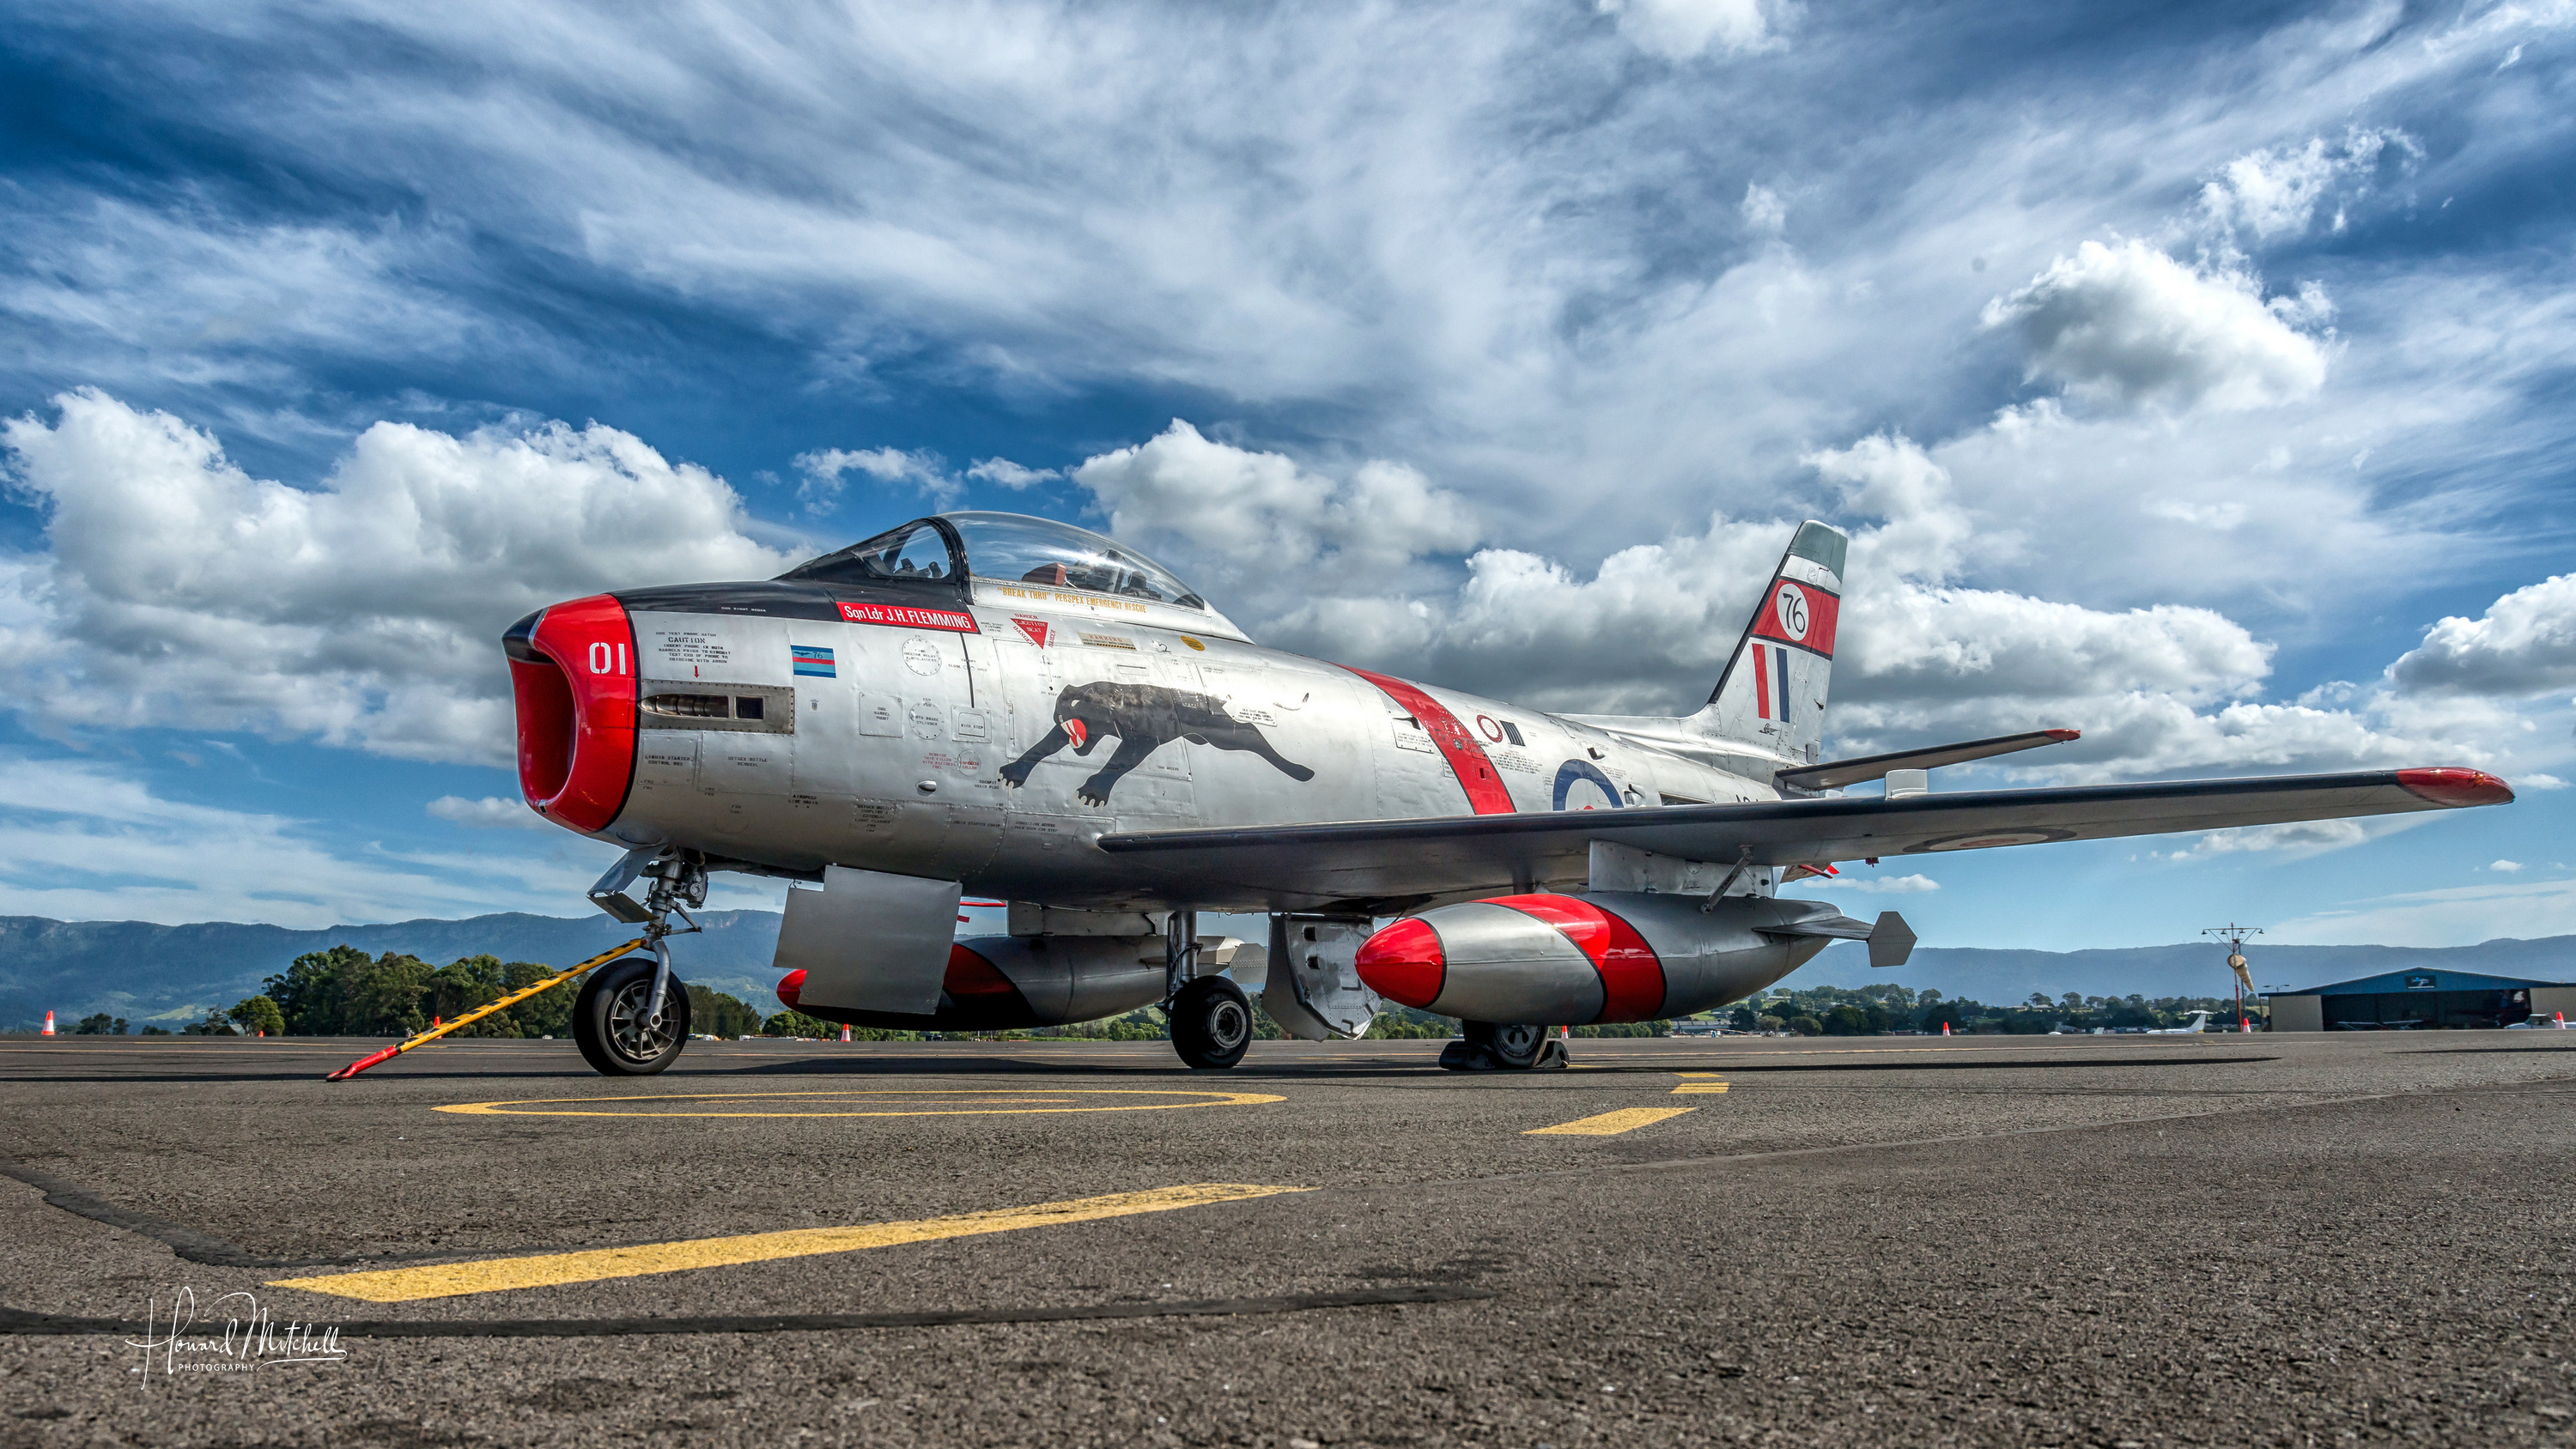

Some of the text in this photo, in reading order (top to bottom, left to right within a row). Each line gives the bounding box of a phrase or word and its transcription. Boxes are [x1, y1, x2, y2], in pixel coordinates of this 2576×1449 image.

[843, 605, 866, 621] Sqn
[865, 606, 883, 621] Ldr
[908, 610, 971, 629] FLEMMING
[1054, 593, 1084, 605] PERSPEX
[1086, 597, 1122, 610] EMERGENCY
[1125, 602, 1146, 614] RESCUE
[1783, 592, 1806, 634] 76
[589, 642, 627, 675] 01
